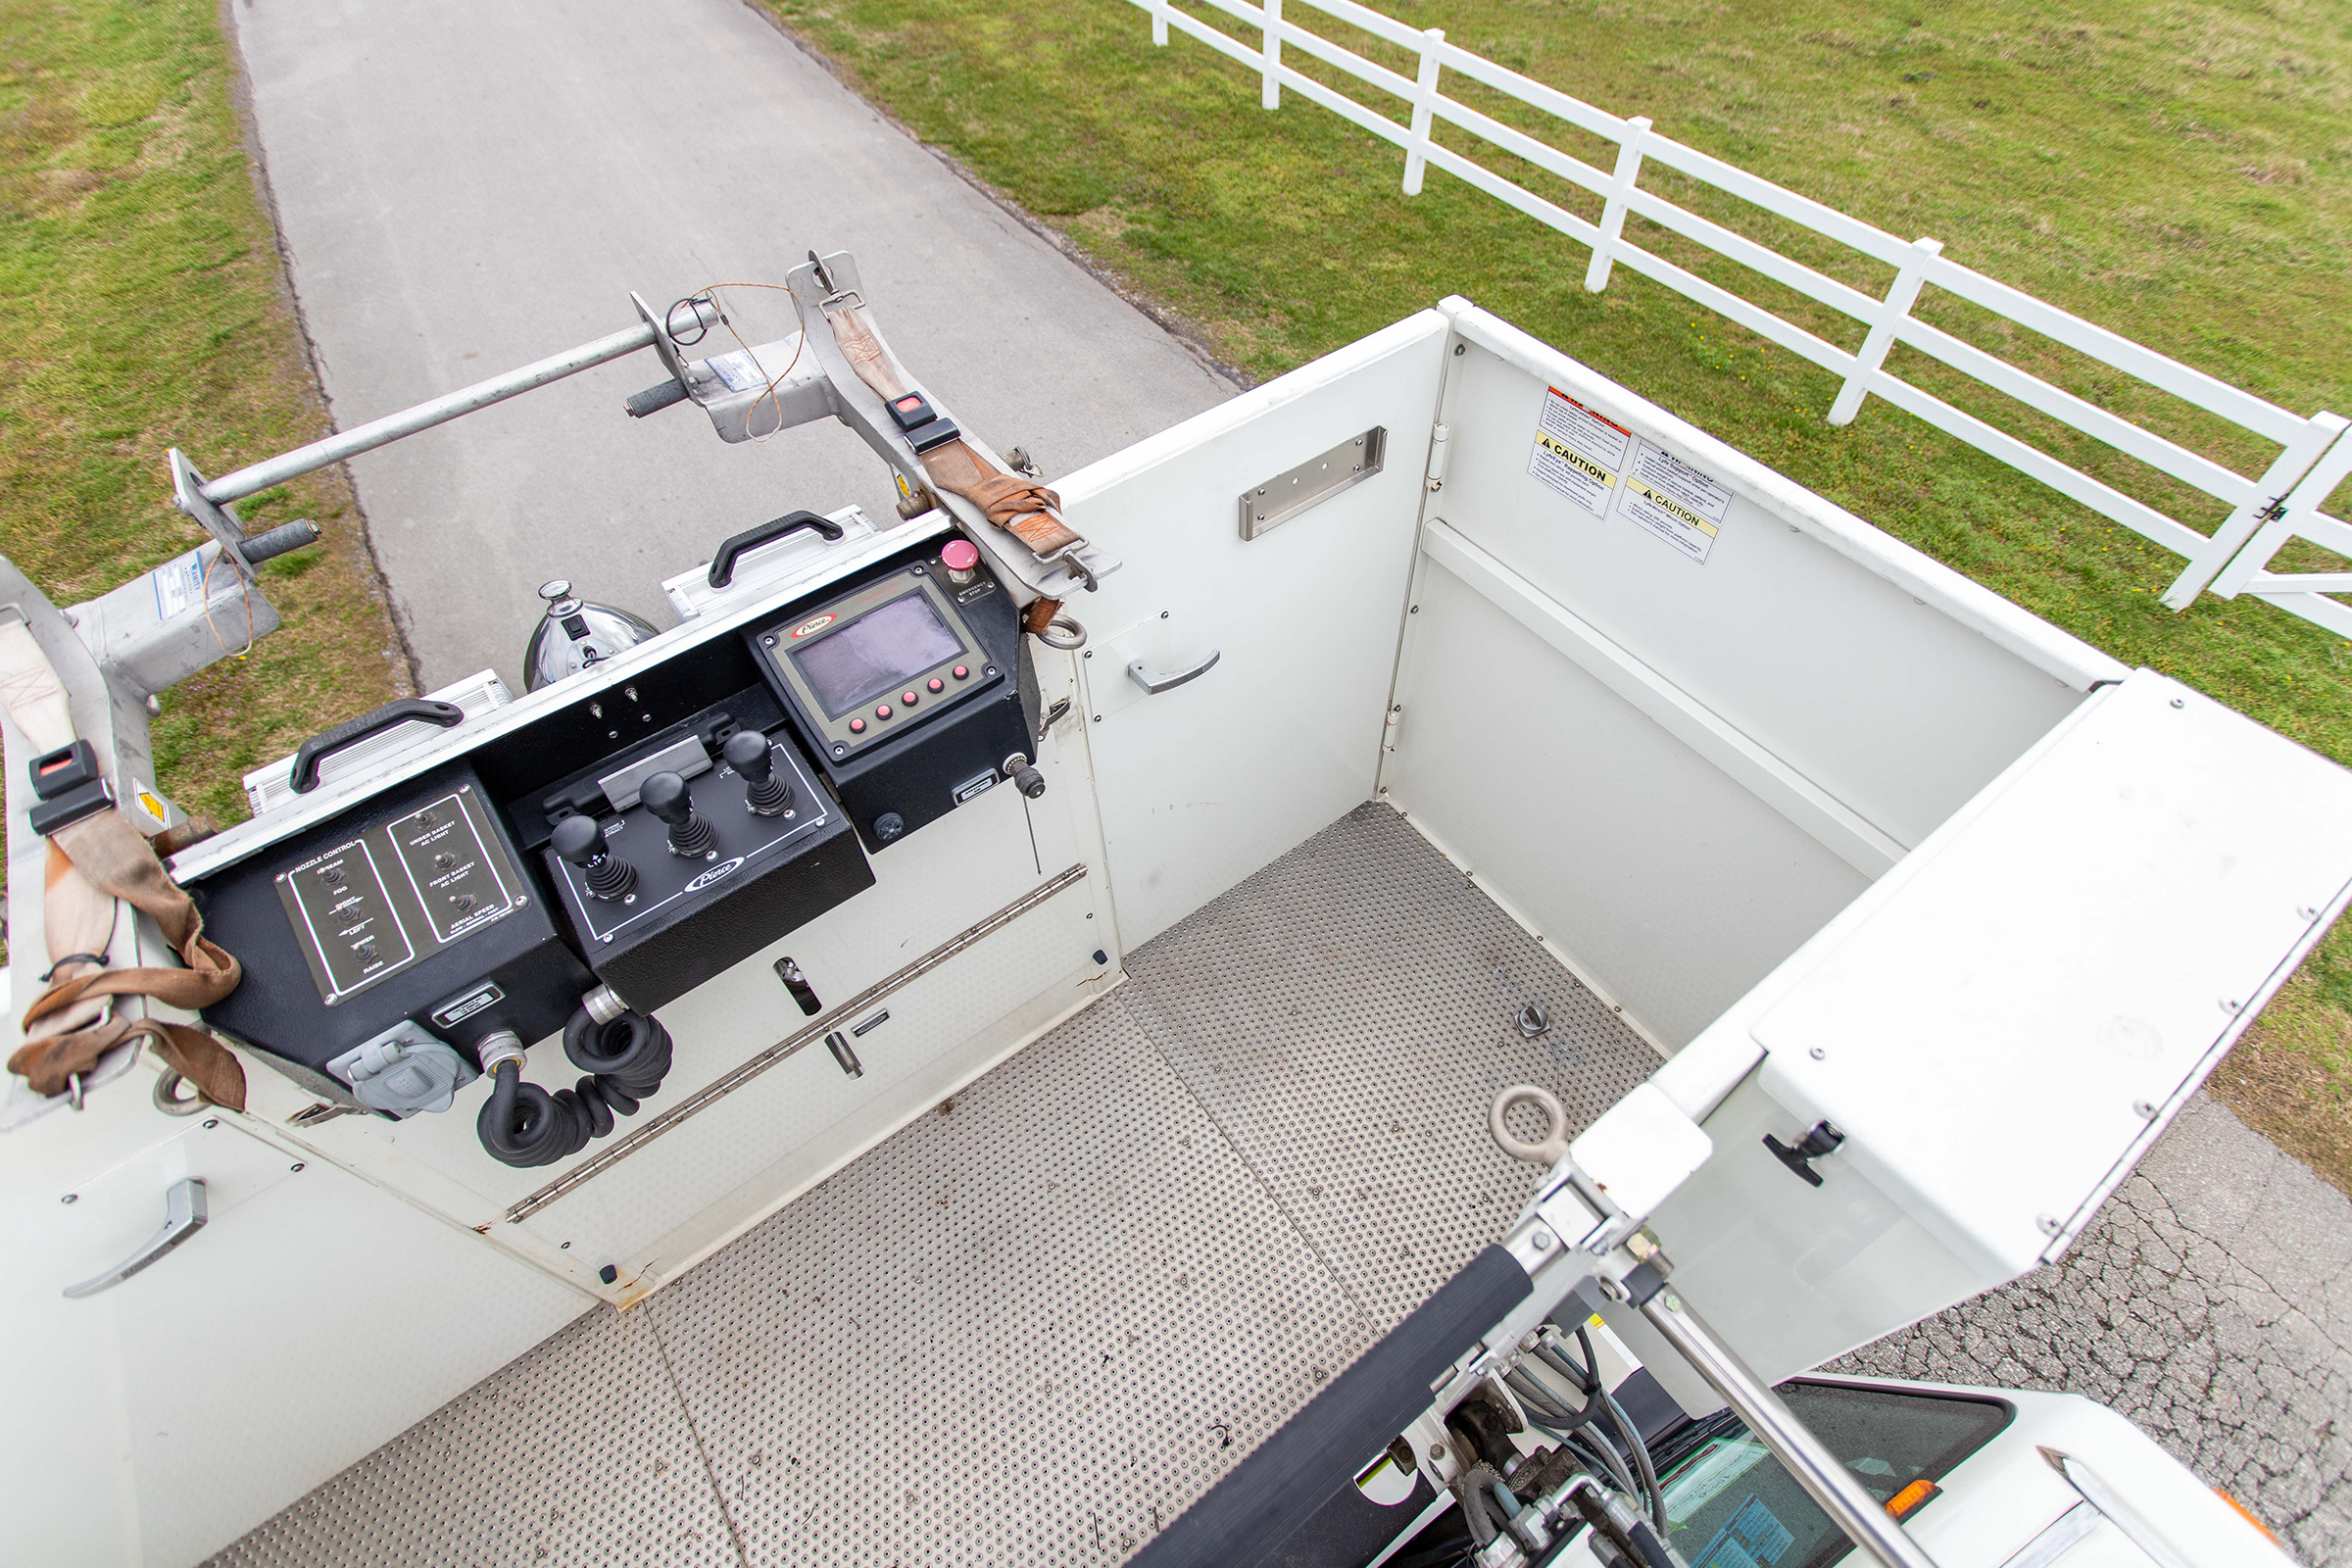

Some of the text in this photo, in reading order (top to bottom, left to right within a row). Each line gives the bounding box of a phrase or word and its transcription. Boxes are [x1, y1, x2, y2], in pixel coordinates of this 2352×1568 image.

[1554, 445, 1606, 481] CAUTION
[1589, 478, 1604, 491] Option
[1691, 476, 1708, 488] Option
[1655, 495, 1699, 526] CAUTION
[958, 582, 986, 596] EMERGENCY
[802, 618, 827, 634] Pierce
[410, 820, 455, 846] UNDER BASKET
[421, 829, 449, 847] AC LIGHT
[295, 841, 356, 873] NOZZLE CONTROL
[587, 853, 608, 868] LIFT
[429, 861, 474, 887] FRONT BASKET
[452, 870, 468, 882] LIGHT
[700, 863, 731, 887] Pierce
[333, 886, 348, 895] FOG
[451, 915, 473, 929] AERIAL
[474, 904, 495, 917] SPEED
[348, 923, 365, 935] LEFT
[364, 960, 383, 974] RAISE
